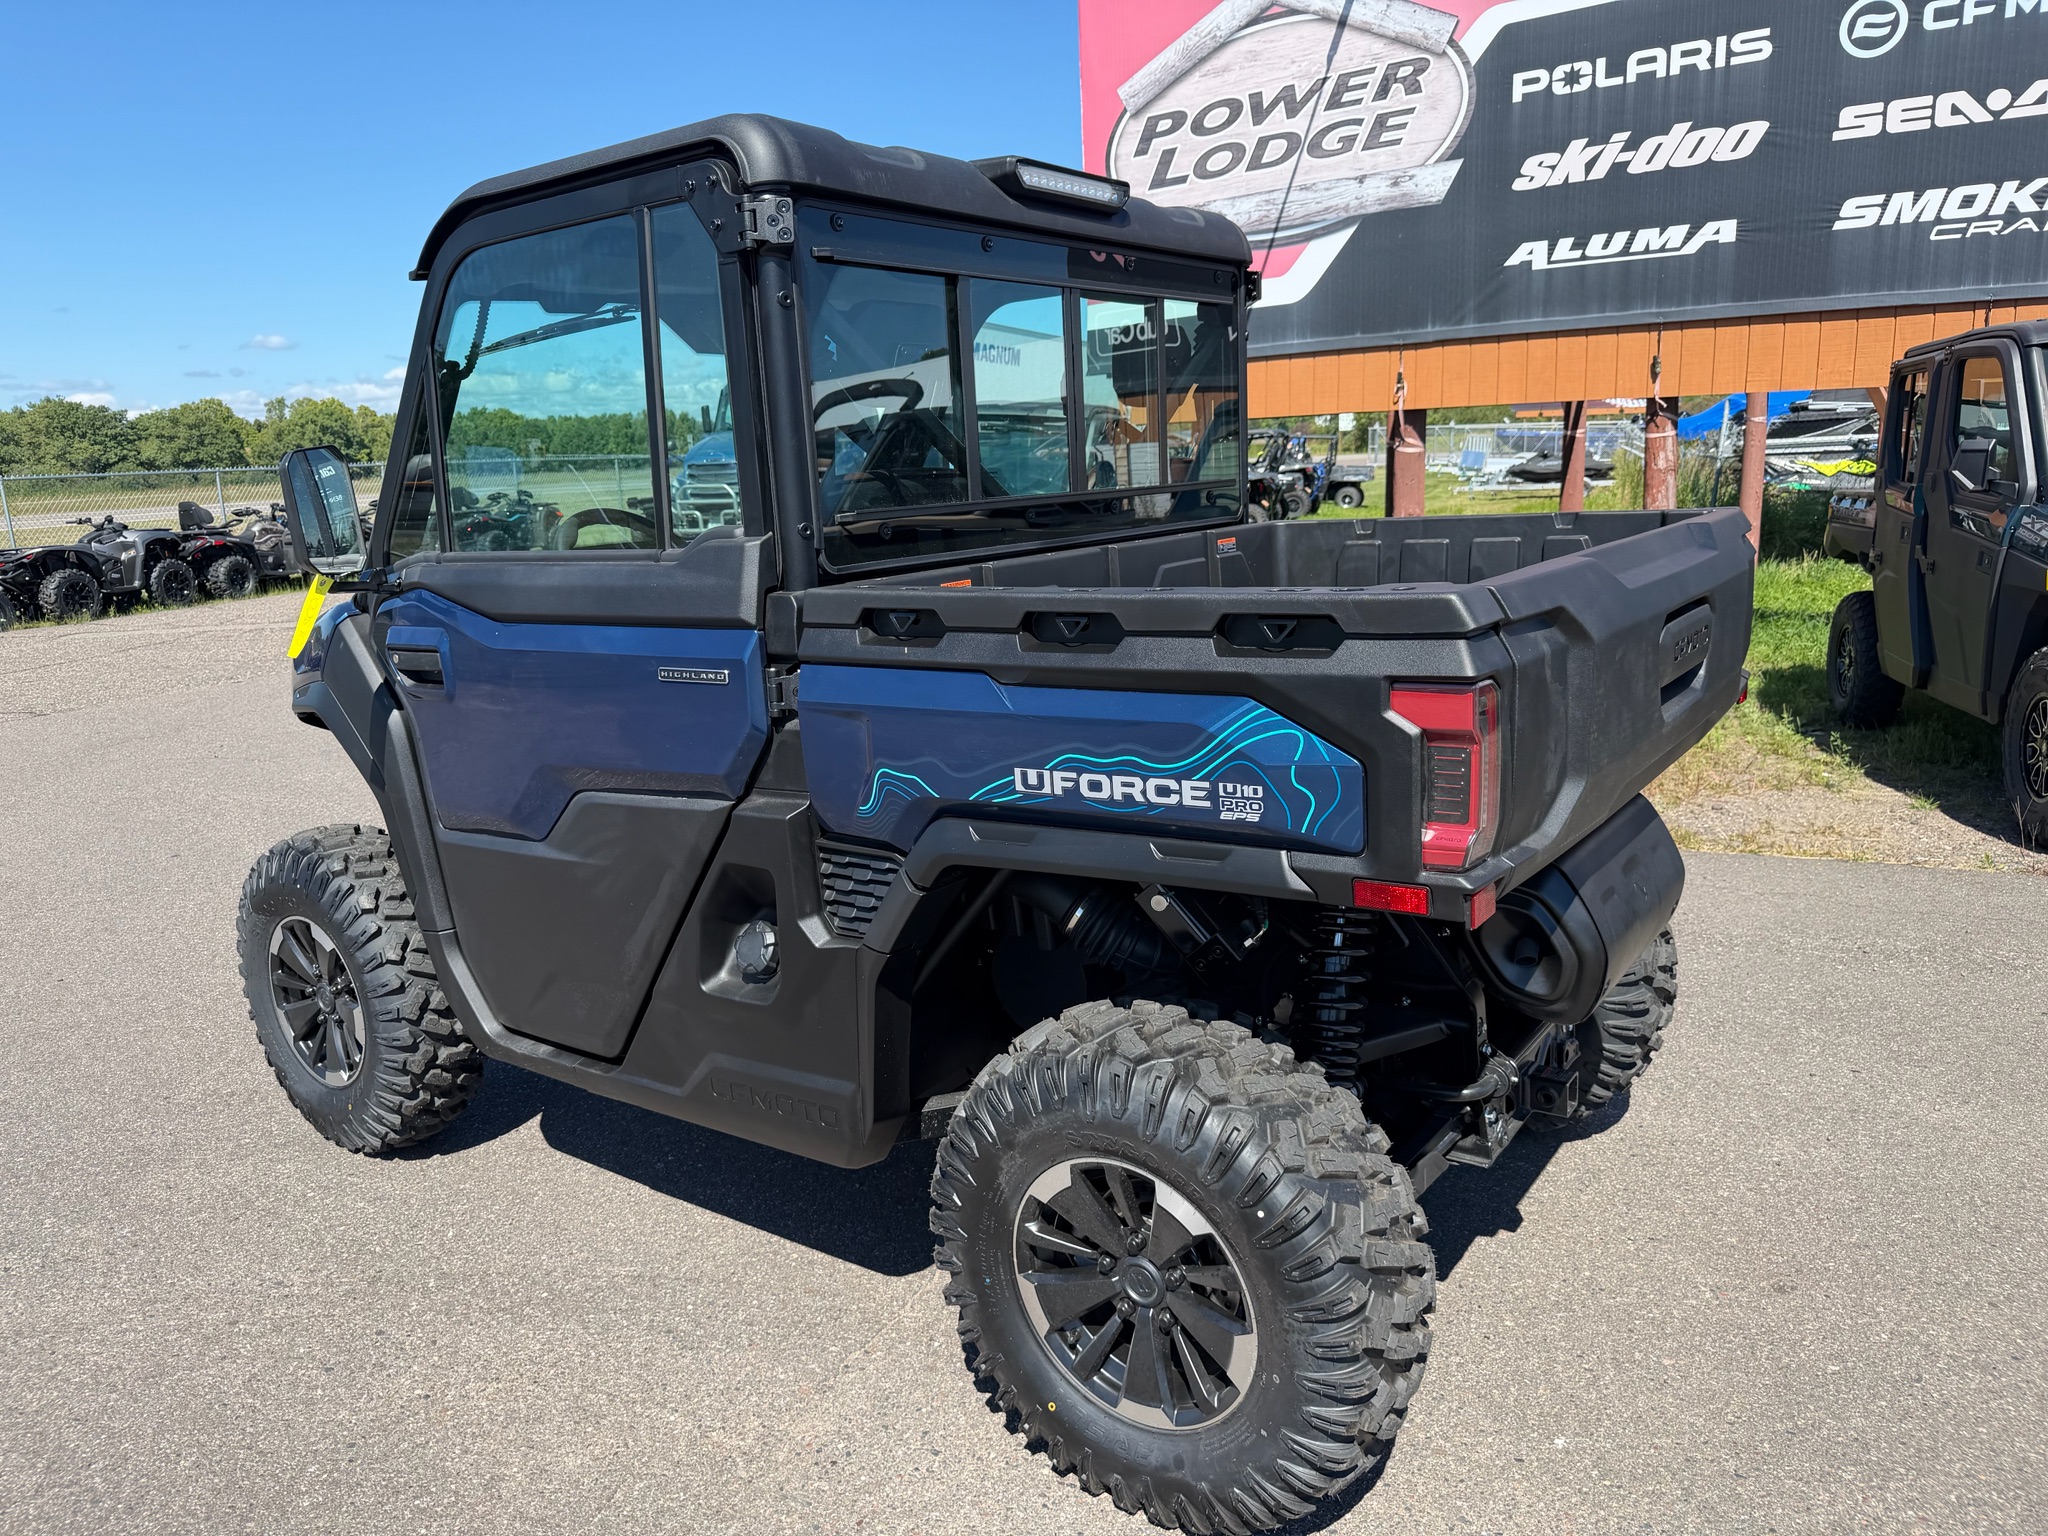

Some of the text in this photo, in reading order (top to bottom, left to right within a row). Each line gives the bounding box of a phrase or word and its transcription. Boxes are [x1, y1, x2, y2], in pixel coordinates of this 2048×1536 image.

[1512, 27, 1773, 103] POLARIS
[1133, 56, 1432, 158] POWER
[1147, 107, 1416, 191] LODGE
[1832, 177, 2048, 230] SMOK
[1503, 219, 1738, 270] ALUMA
[1929, 216, 2048, 241] CRA
[2017, 527, 2041, 543] 1000
[660, 671, 725, 680] HIGHLAND
[1013, 767, 1263, 809] UFORCE U10
[1219, 798, 1264, 813] PRO
[1219, 812, 1261, 822] EPS
[710, 1077, 839, 1130] CFMOTO
